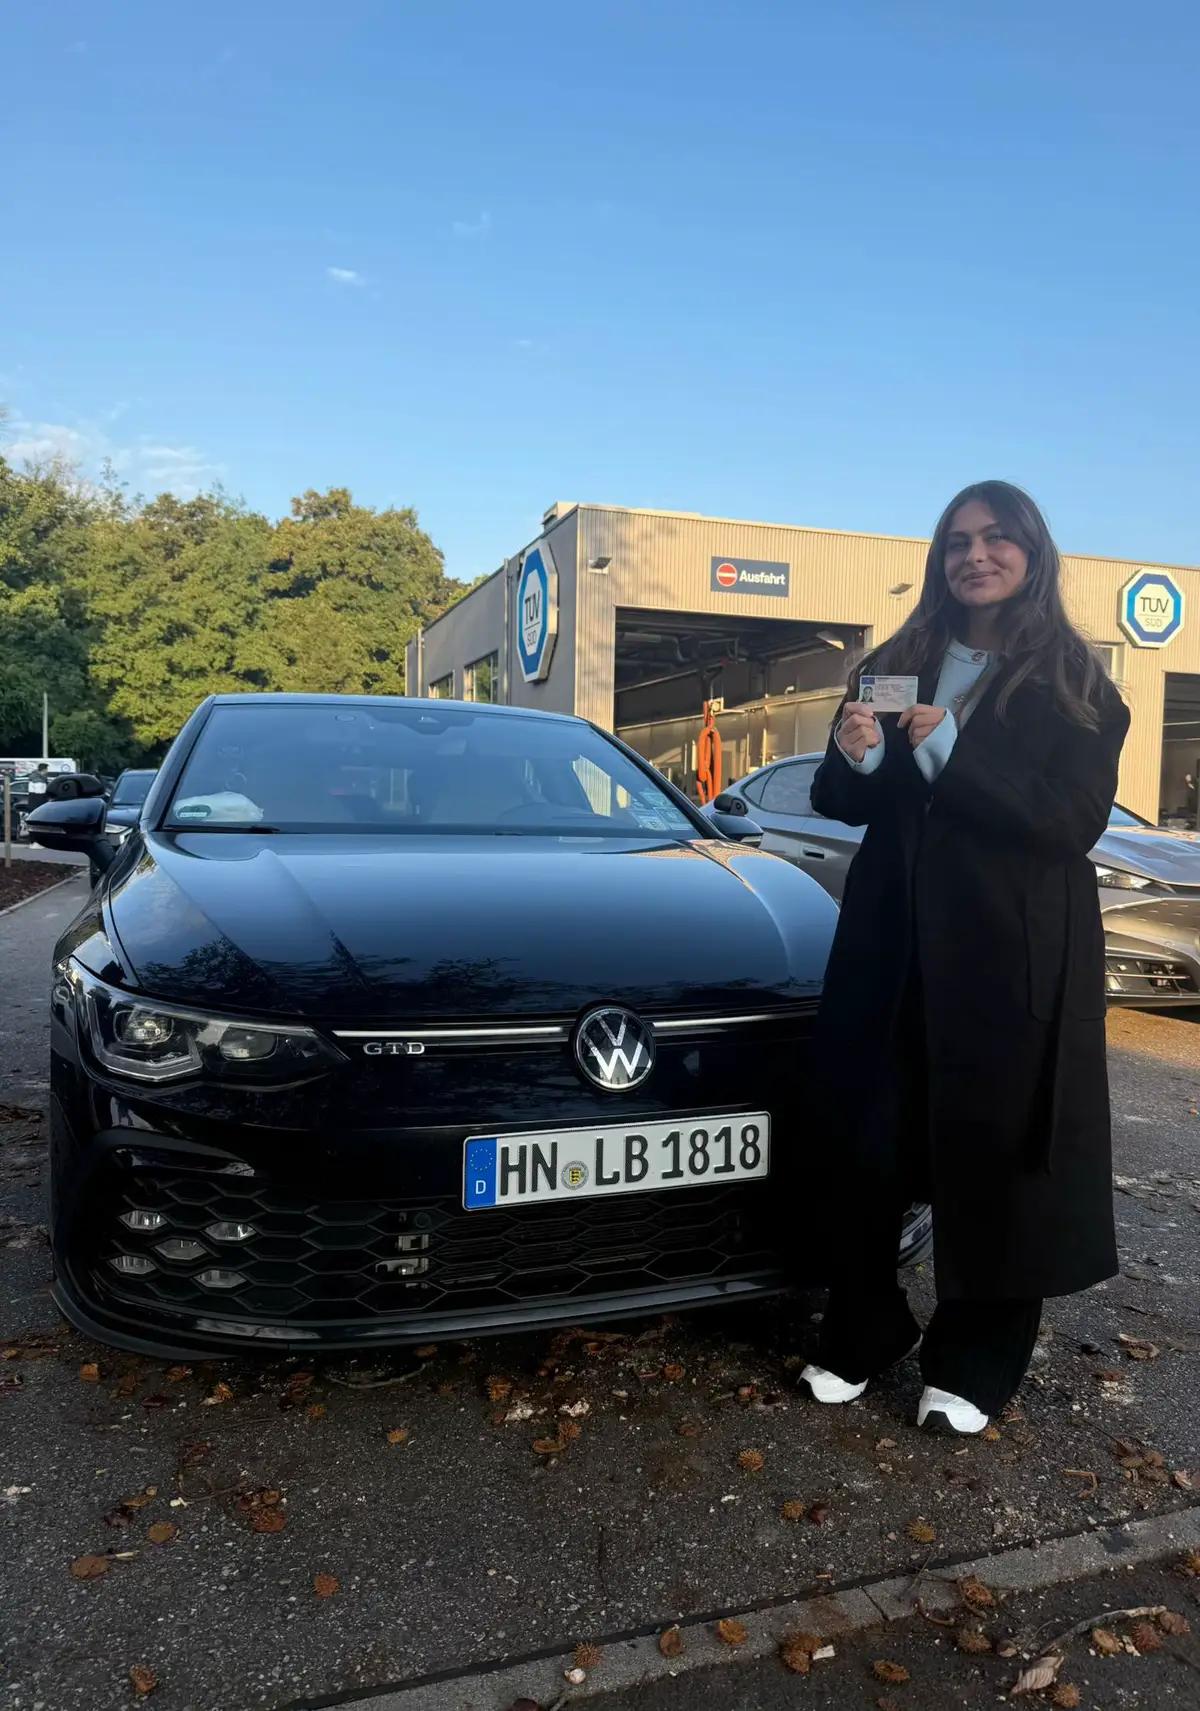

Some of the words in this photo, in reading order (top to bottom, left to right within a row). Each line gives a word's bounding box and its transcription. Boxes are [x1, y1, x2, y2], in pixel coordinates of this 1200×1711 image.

[739, 570, 786, 585] Ausfahrt
[363, 1042, 425, 1055] GTD
[501, 1141, 558, 1196] HN
[595, 1134, 649, 1186] LB
[661, 1124, 761, 1180] 1818
[475, 1180, 486, 1195] D
